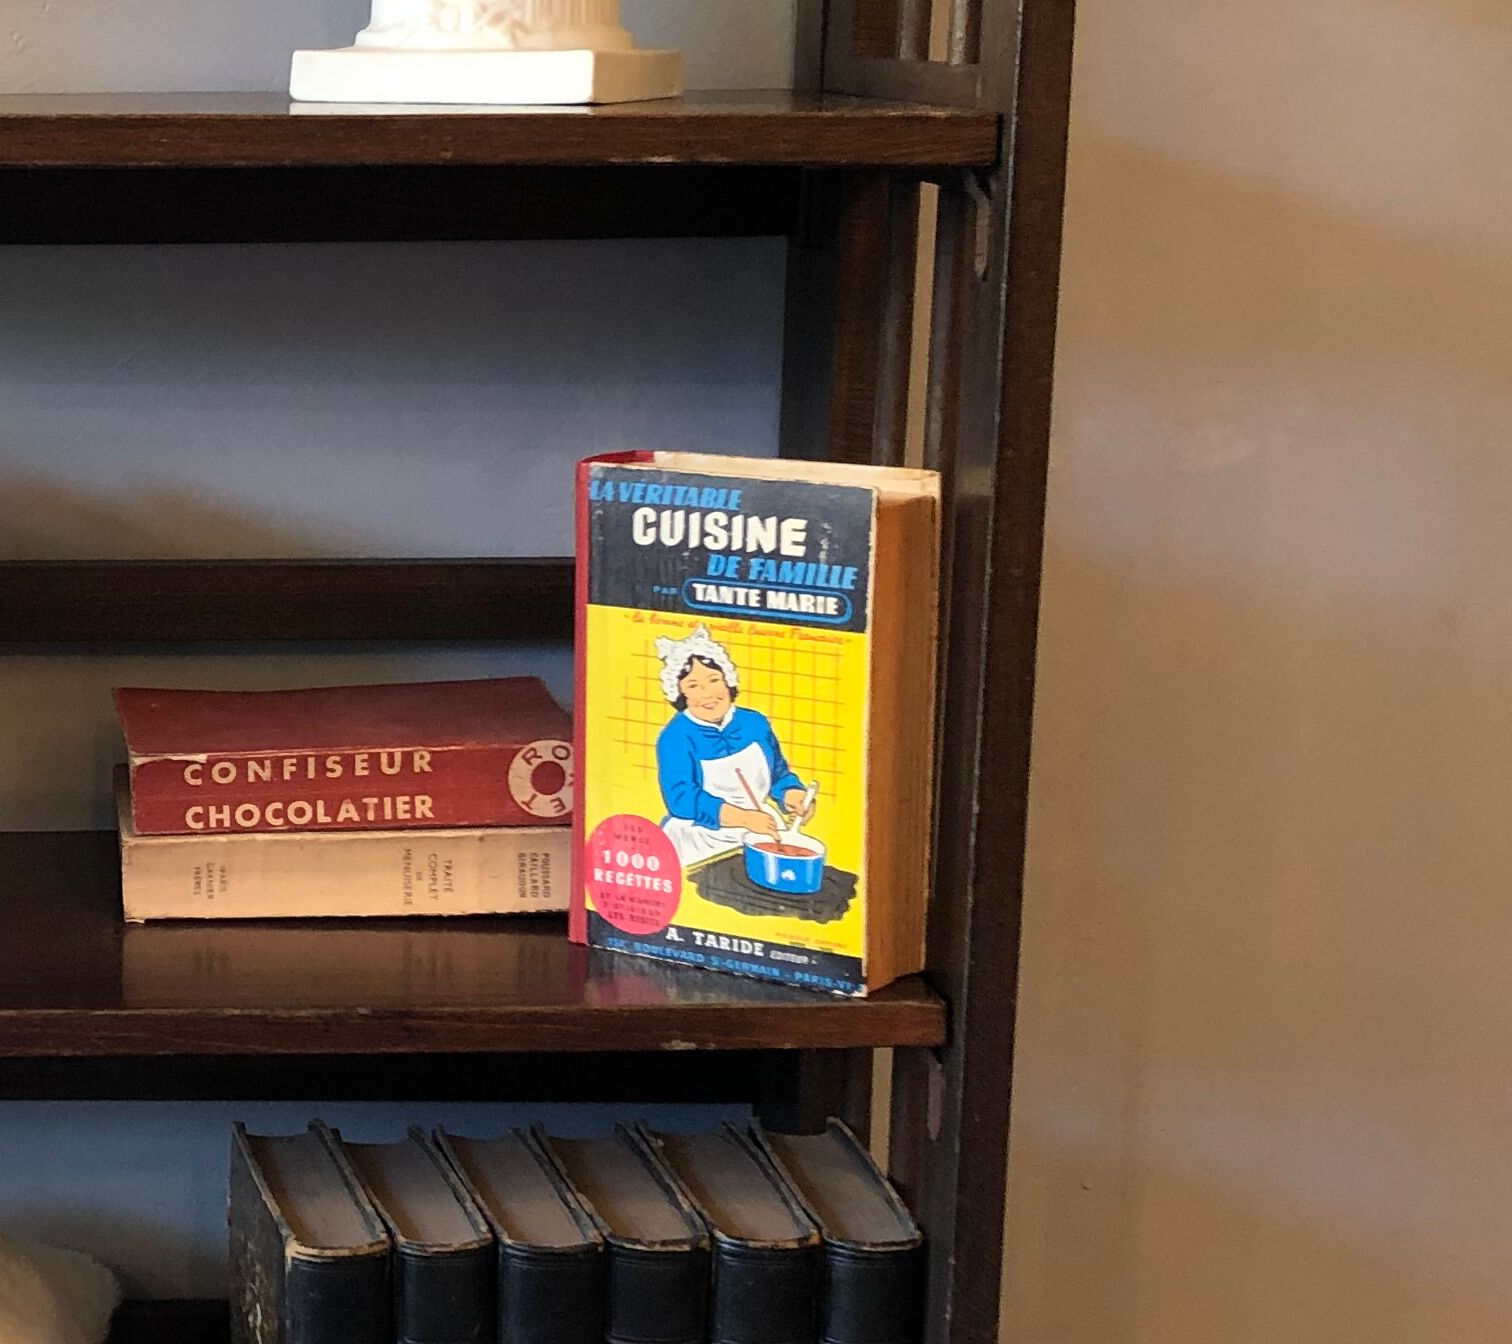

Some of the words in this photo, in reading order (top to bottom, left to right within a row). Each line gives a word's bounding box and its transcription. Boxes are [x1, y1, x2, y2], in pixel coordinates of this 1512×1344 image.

[589, 479, 616, 503] LA
[617, 477, 744, 512] VÉRITABLE
[631, 505, 809, 558] CUISINE
[705, 554, 743, 578] DE
[747, 555, 860, 592] FAMILLE
[691, 581, 763, 609] TANTE
[765, 589, 841, 617] MARIE
[182, 748, 434, 787] CONFISEUR
[183, 794, 435, 831] CHOCOLATIER
[426, 852, 439, 901] COMPLET
[602, 848, 662, 873] 1000
[592, 867, 675, 895] RECETTES
[665, 926, 686, 943] A.
[691, 931, 765, 958] TARIDE
